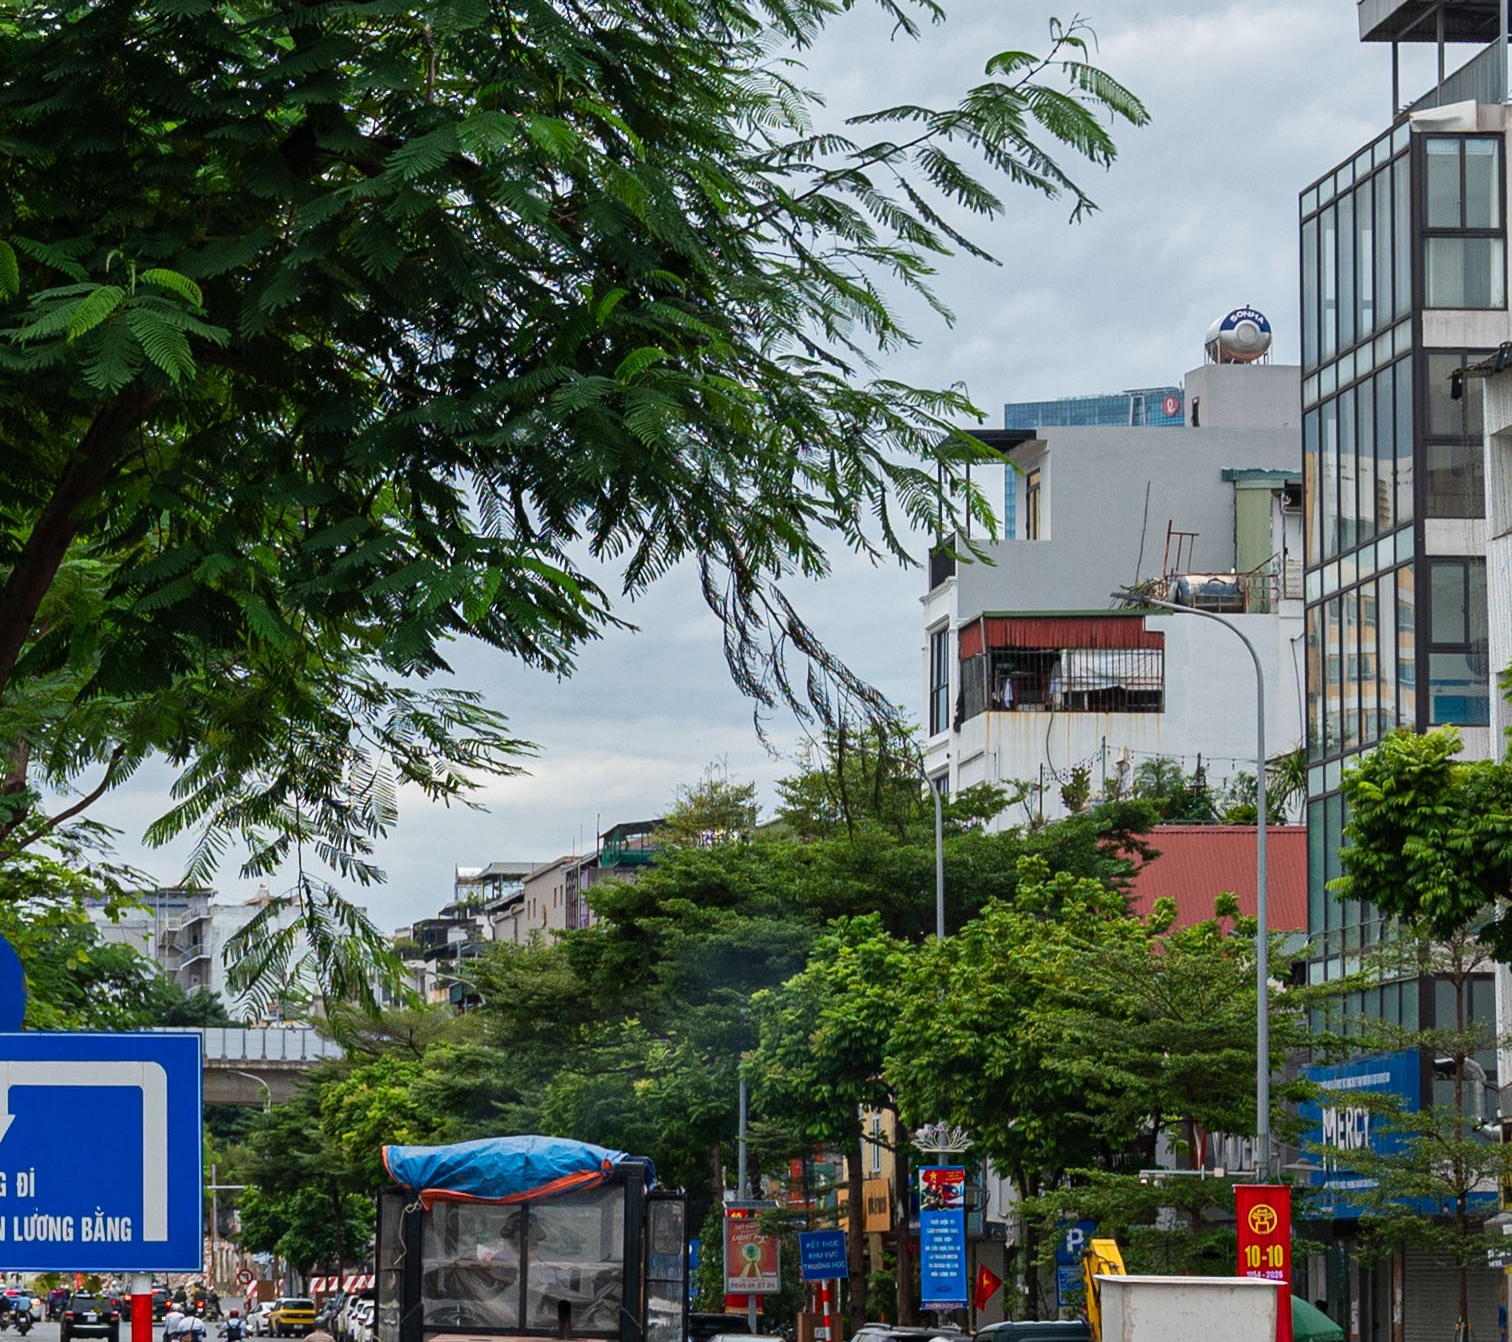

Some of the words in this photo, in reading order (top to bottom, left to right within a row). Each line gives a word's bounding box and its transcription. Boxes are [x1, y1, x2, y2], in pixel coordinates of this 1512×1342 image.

[1322, 1107, 1370, 1150] MERCY
[16, 1166, 36, 1198] ĐI
[80, 1206, 132, 1243] BẰNG
[1066, 1228, 1084, 1252] P
[1244, 1244, 1284, 1268] 10-10
